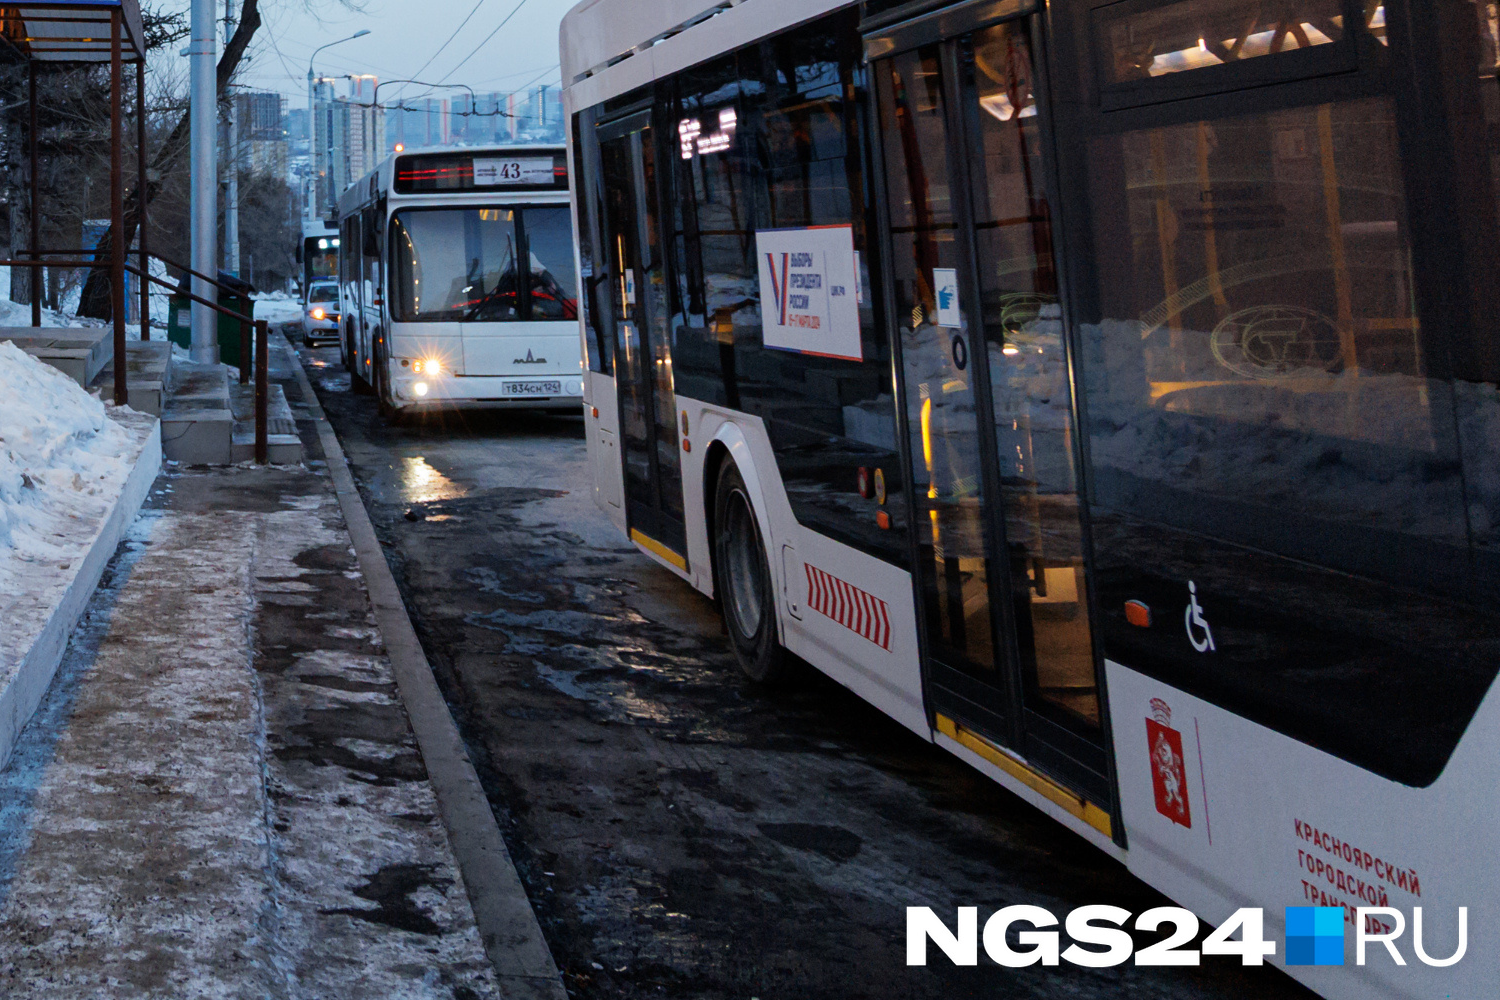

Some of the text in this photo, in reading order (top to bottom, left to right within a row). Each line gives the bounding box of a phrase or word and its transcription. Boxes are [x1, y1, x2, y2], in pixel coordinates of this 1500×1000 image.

[501, 163, 521, 179] 43
[1294, 818, 1421, 898] КРАСНОЯРСКИЙ
[1298, 848, 1389, 907] ГОРОДСКОЙ
